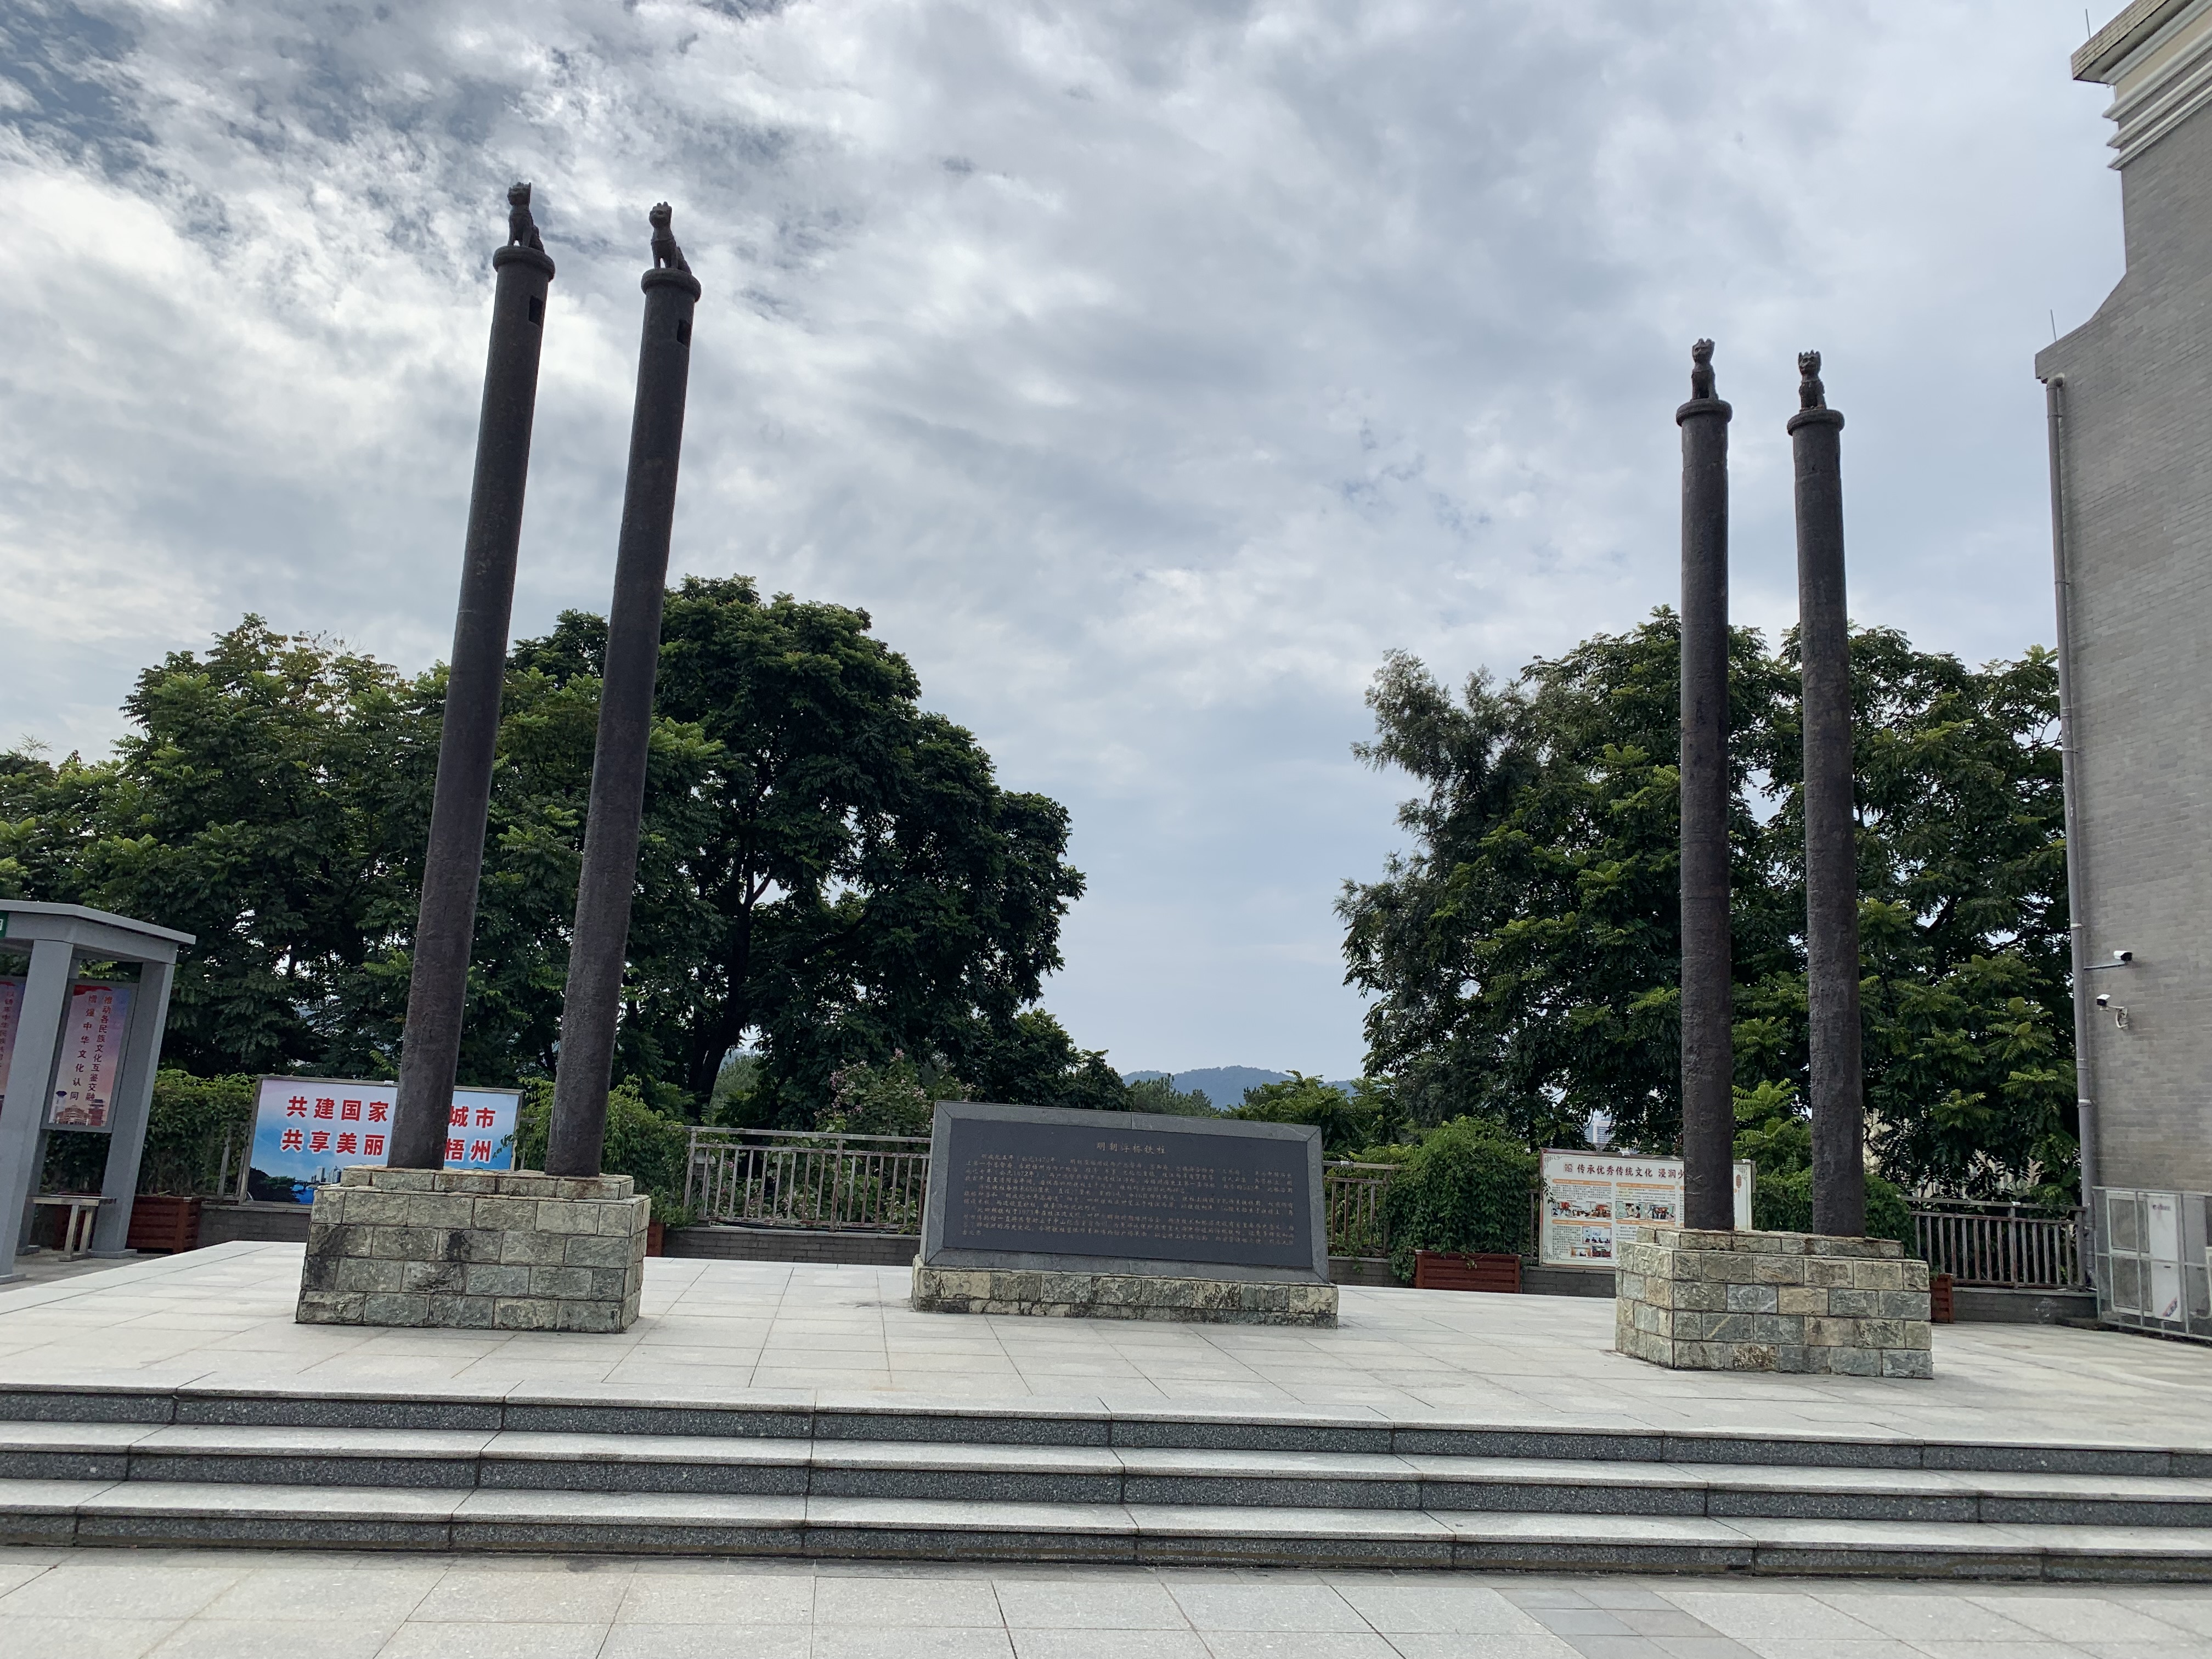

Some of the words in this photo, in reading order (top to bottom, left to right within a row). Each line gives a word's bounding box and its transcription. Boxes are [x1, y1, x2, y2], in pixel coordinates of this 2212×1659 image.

[70, 995, 97, 1101] 增强中华文化认同
[85, 996, 112, 1101] 推动各民族文化互鉴交融
[286, 1096, 495, 1128] 共建国家城市
[282, 1129, 491, 1161] 共享美丽梧州
[1577, 1164, 1652, 1177] 传承优秀传统文化
